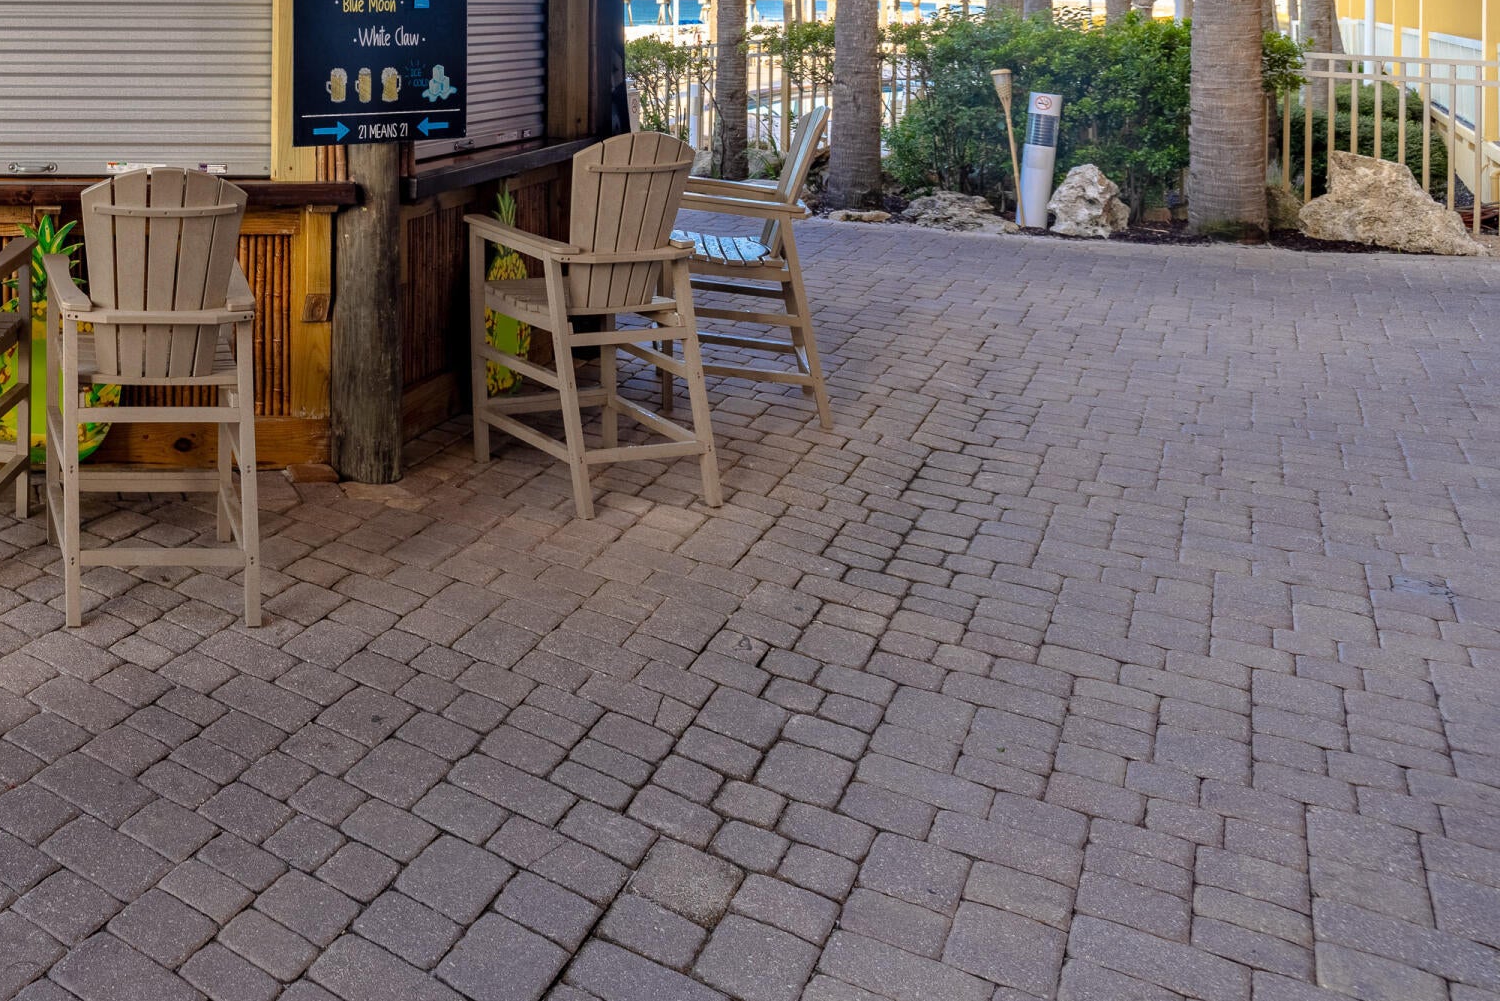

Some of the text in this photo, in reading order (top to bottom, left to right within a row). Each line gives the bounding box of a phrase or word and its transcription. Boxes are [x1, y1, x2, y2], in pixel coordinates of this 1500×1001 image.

[358, 25, 420, 47] White Claw
[358, 122, 409, 140] 21 MEANS 21
